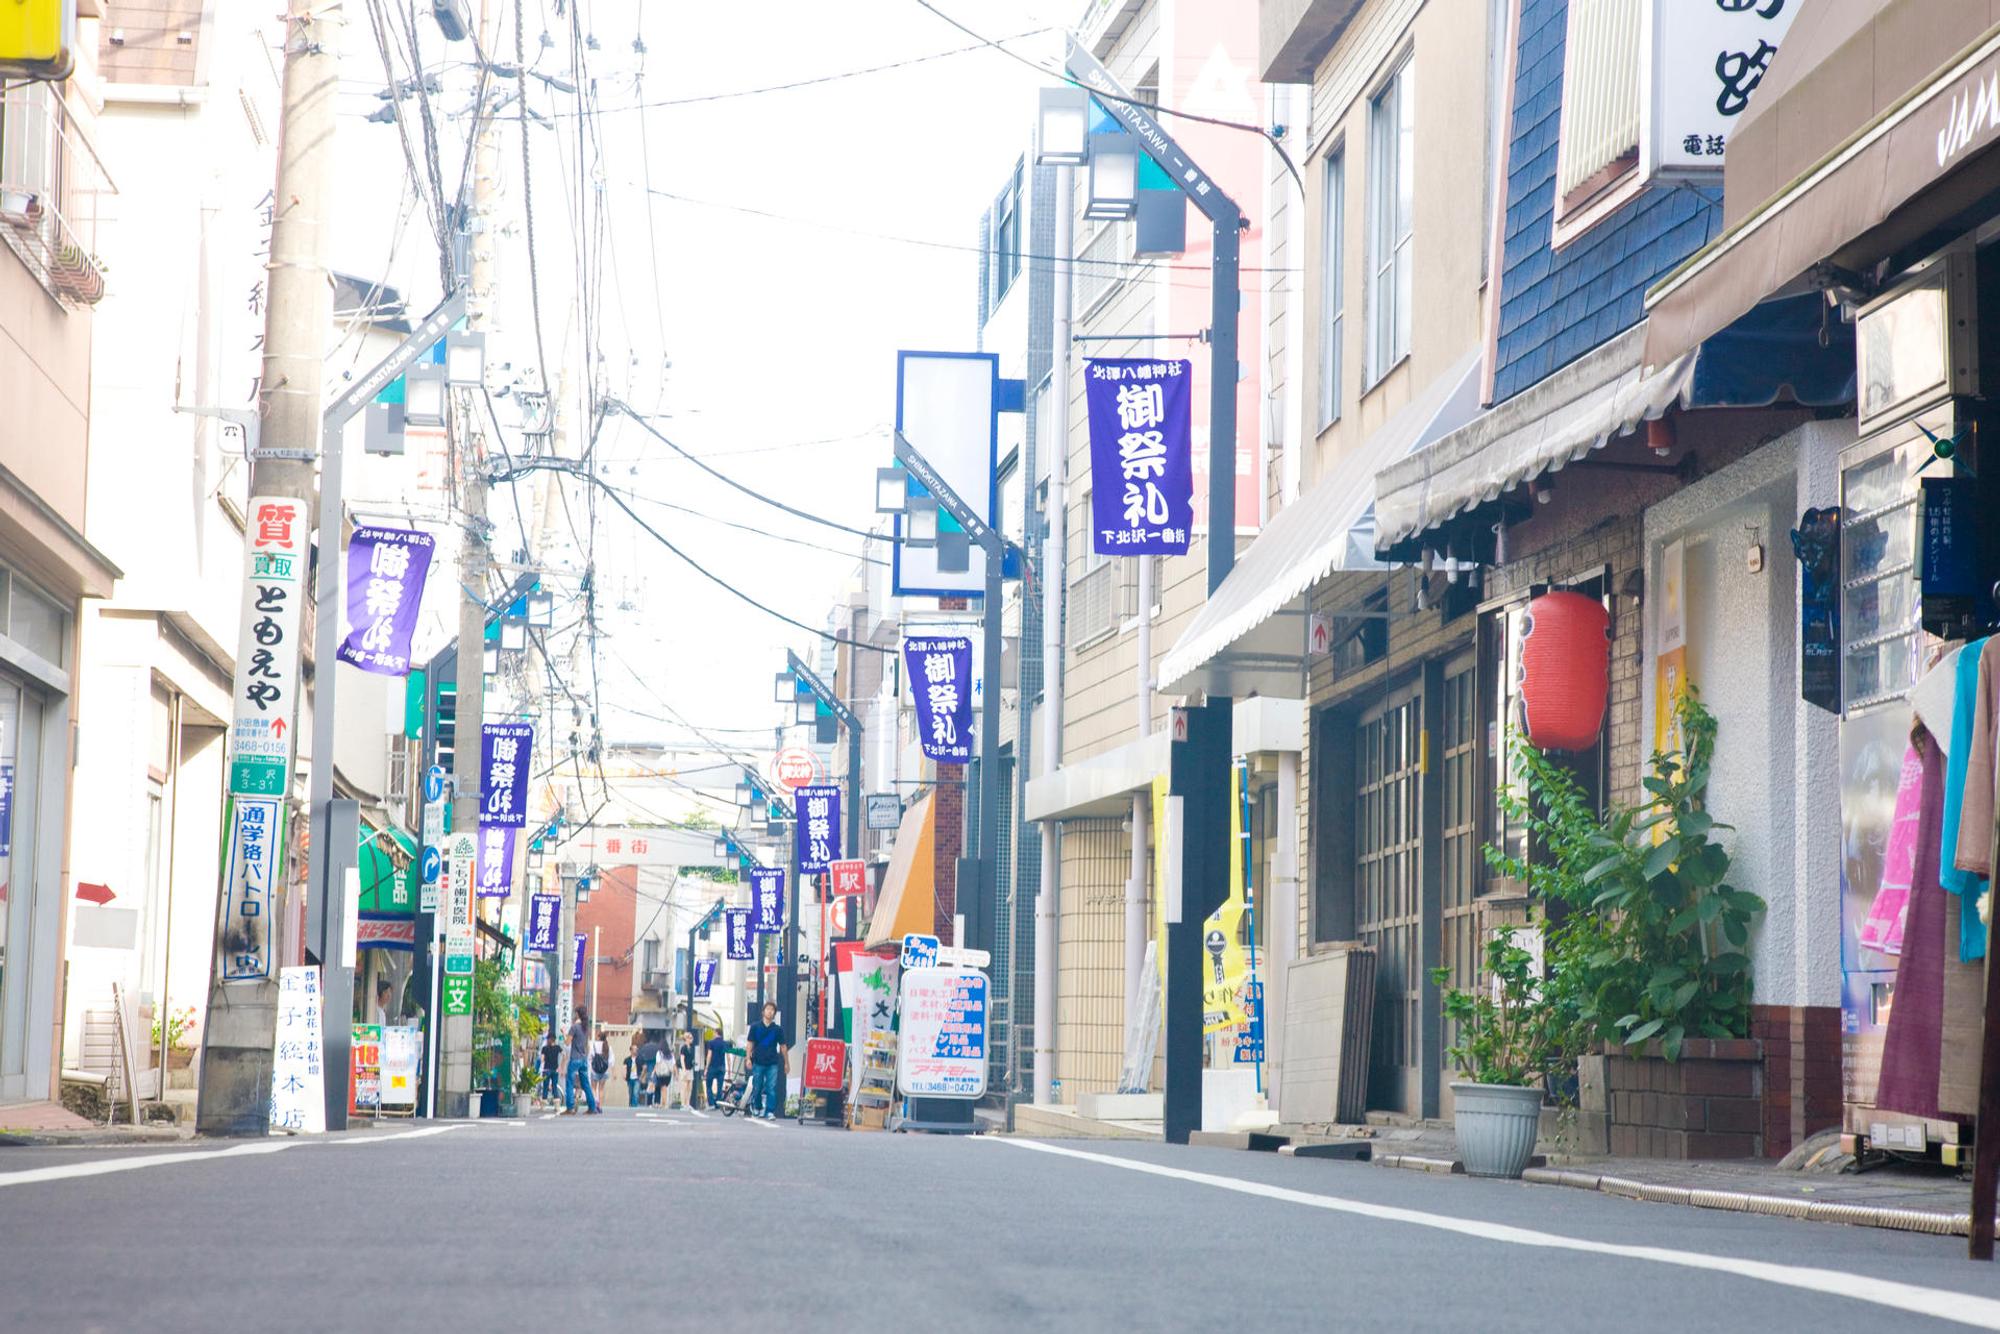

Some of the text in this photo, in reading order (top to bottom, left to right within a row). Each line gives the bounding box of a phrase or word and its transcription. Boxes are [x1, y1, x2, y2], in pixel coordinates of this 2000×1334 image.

[1683, 134, 1725, 155] 電話
[1116, 383, 1169, 528] 御祭礼
[255, 504, 296, 549] 質
[1101, 528, 1185, 544] 下北沢一番街
[254, 557, 292, 576] 買取
[246, 585, 287, 711] ともえや
[924, 653, 958, 745] 御祭礼
[240, 780, 274, 791] 3-31
[807, 797, 831, 862] 御祭礼
[579, 839, 650, 854] 一番街
[839, 872, 861, 891] 駅
[447, 988, 467, 1008] 文
[814, 1053, 838, 1073] 駅
